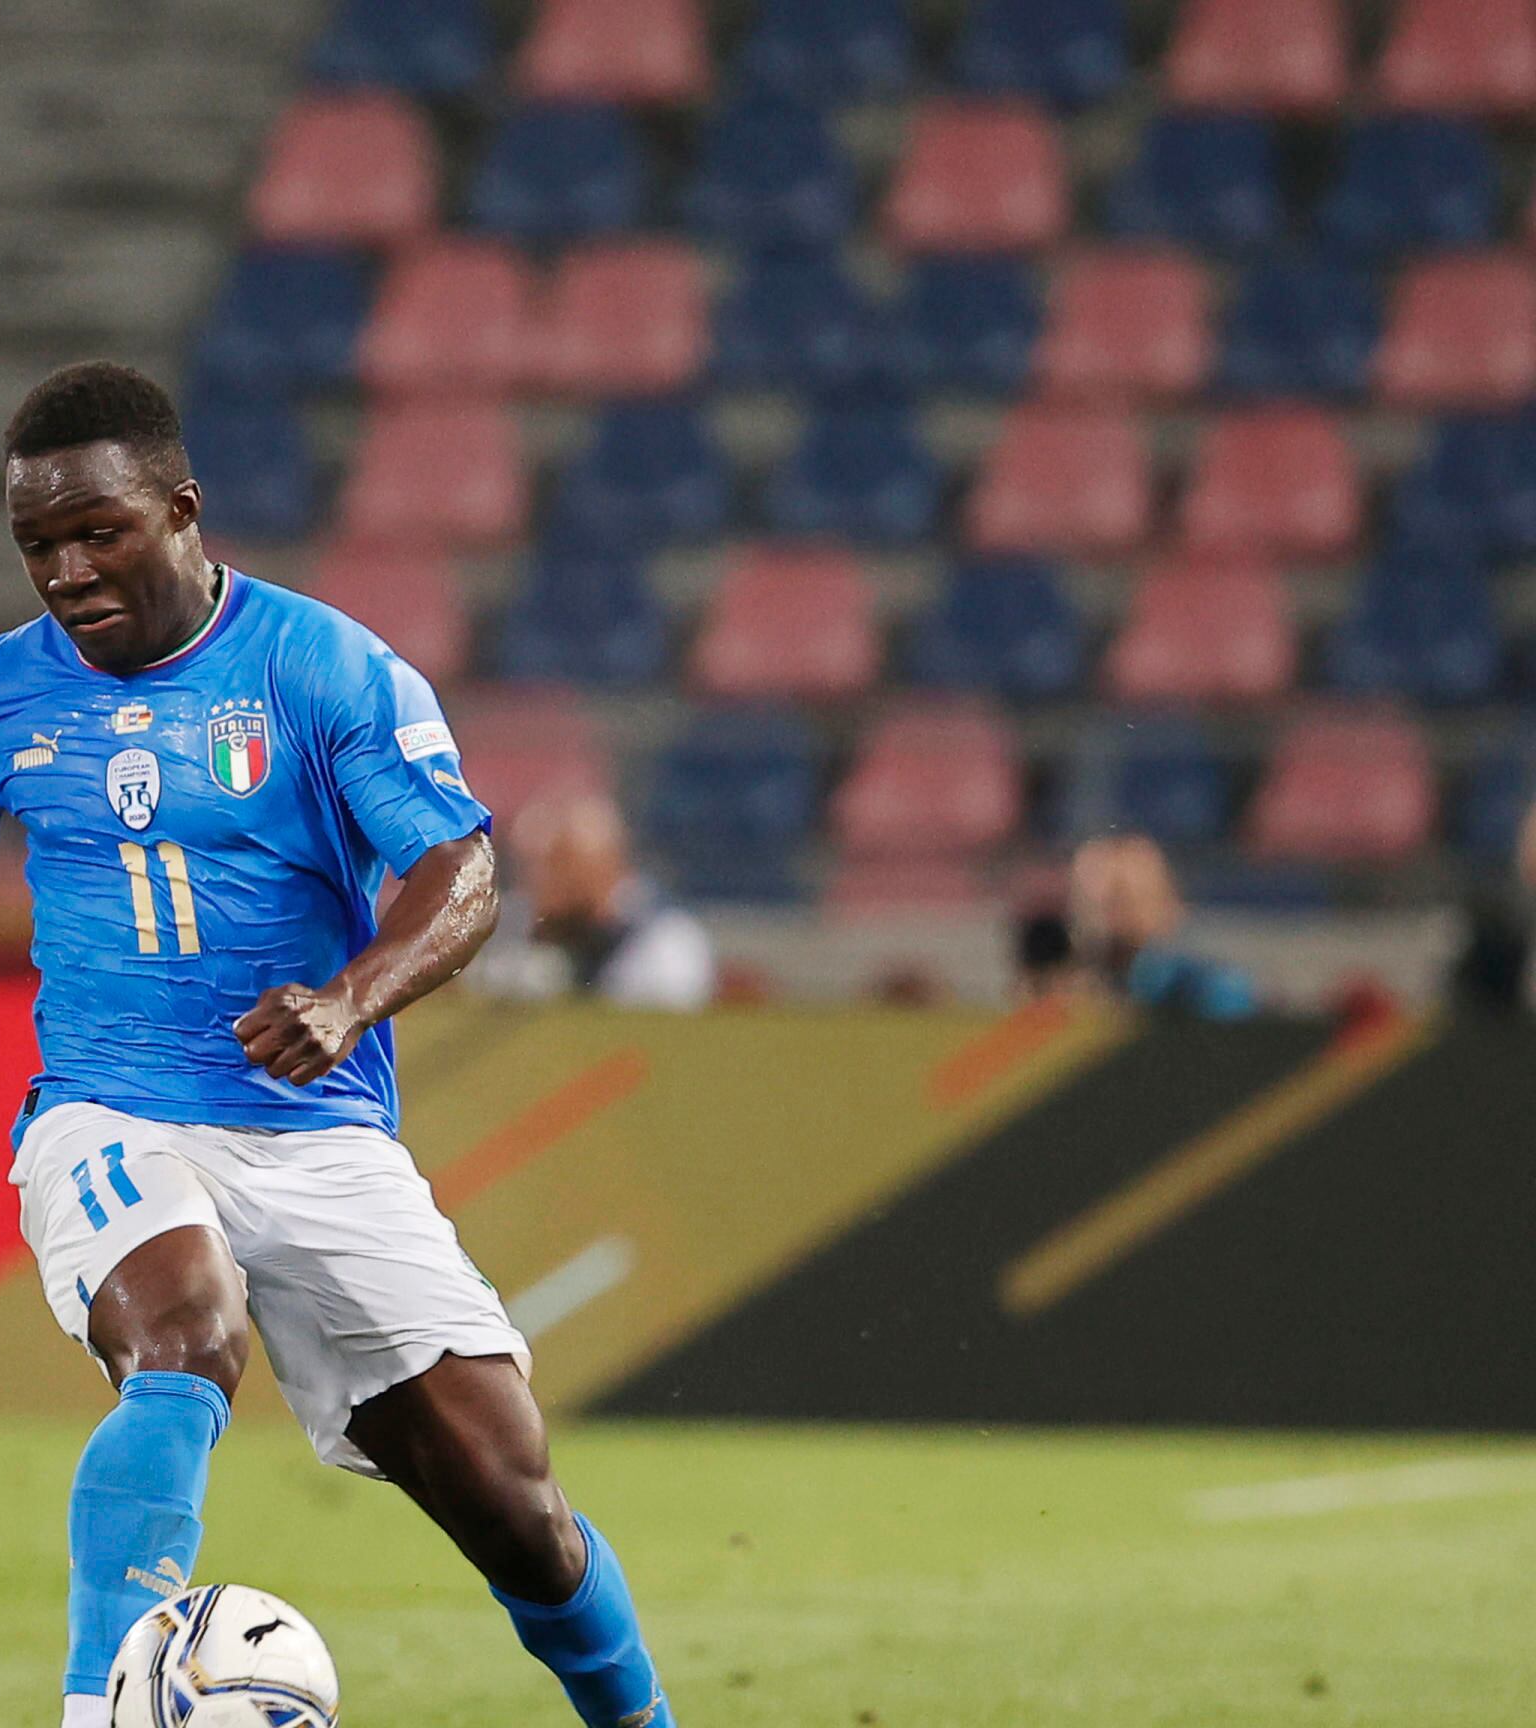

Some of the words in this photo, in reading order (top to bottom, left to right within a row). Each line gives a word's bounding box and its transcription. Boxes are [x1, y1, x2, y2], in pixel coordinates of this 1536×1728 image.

[214, 719, 263, 737] ITALIA
[128, 813, 148, 822] 2020
[117, 840, 201, 955] 11
[70, 1141, 143, 1232] 11
